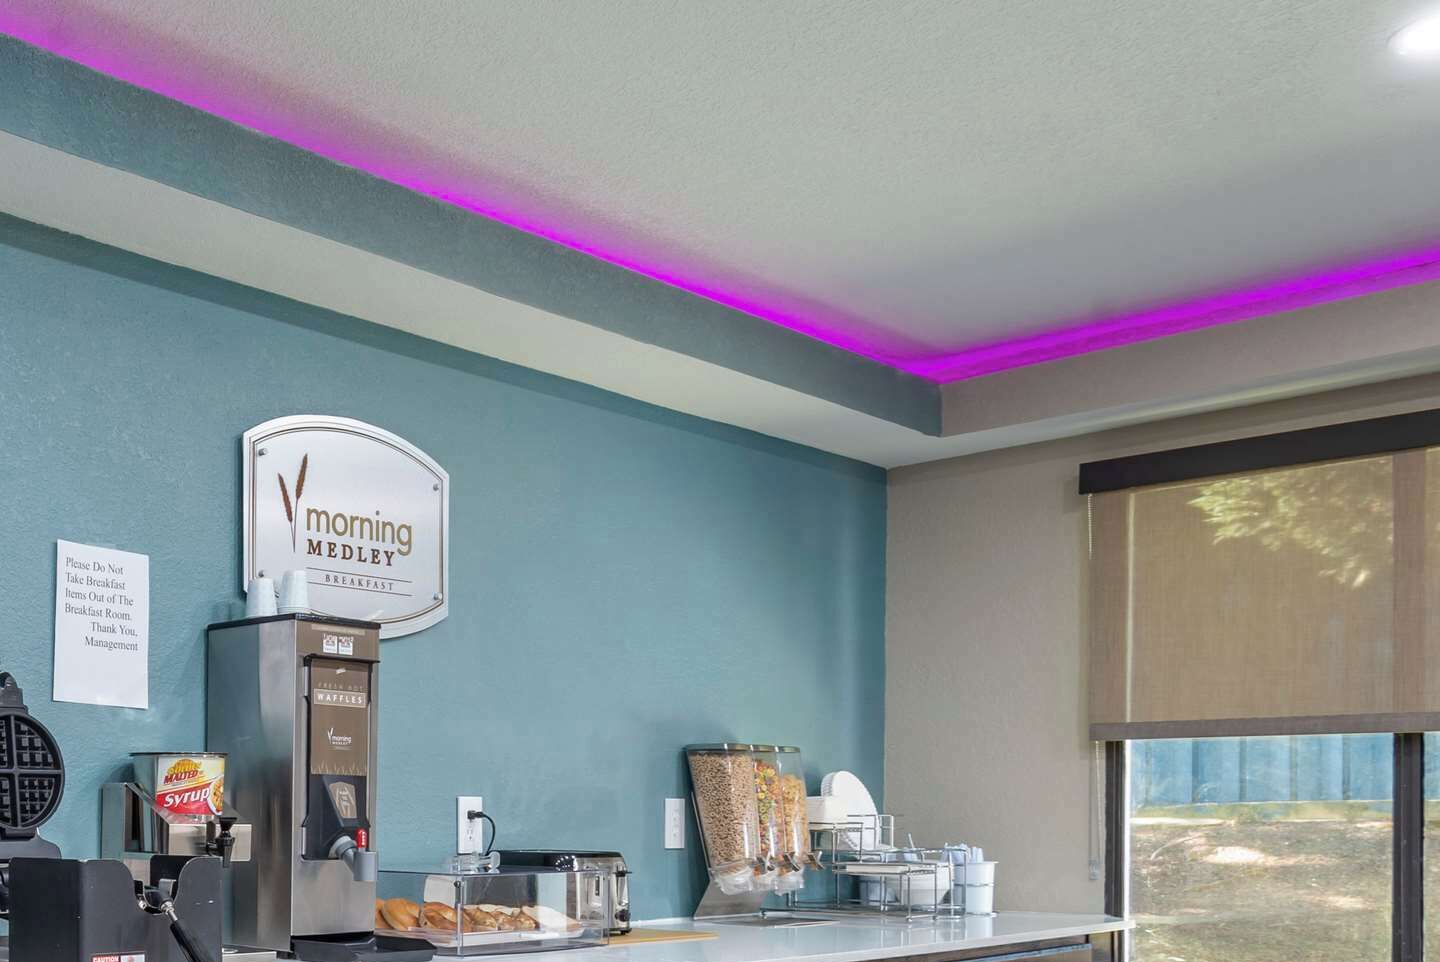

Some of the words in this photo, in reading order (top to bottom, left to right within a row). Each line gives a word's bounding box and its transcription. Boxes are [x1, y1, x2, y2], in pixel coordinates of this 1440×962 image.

[306, 507, 412, 556] morning
[307, 539, 395, 566] MEDLEY
[65, 556, 91, 570] Please
[93, 561, 106, 572] Do
[108, 563, 124, 575] Not
[65, 572, 84, 584] Take
[86, 576, 126, 590] Breakfast
[325, 574, 394, 591] BREAKFAST
[65, 588, 87, 600] Items
[88, 592, 104, 603] Out
[106, 594, 116, 604] of
[118, 594, 134, 606] The
[65, 603, 103, 618] Breakfast
[105, 608, 132, 621] Room.
[90, 622, 118, 634] Thank
[119, 624, 138, 637] You,
[85, 636, 139, 651] Management
[317, 694, 362, 704] WAFFLES
[164, 770, 200, 785] MALTED
[164, 788, 210, 808] Syrup
